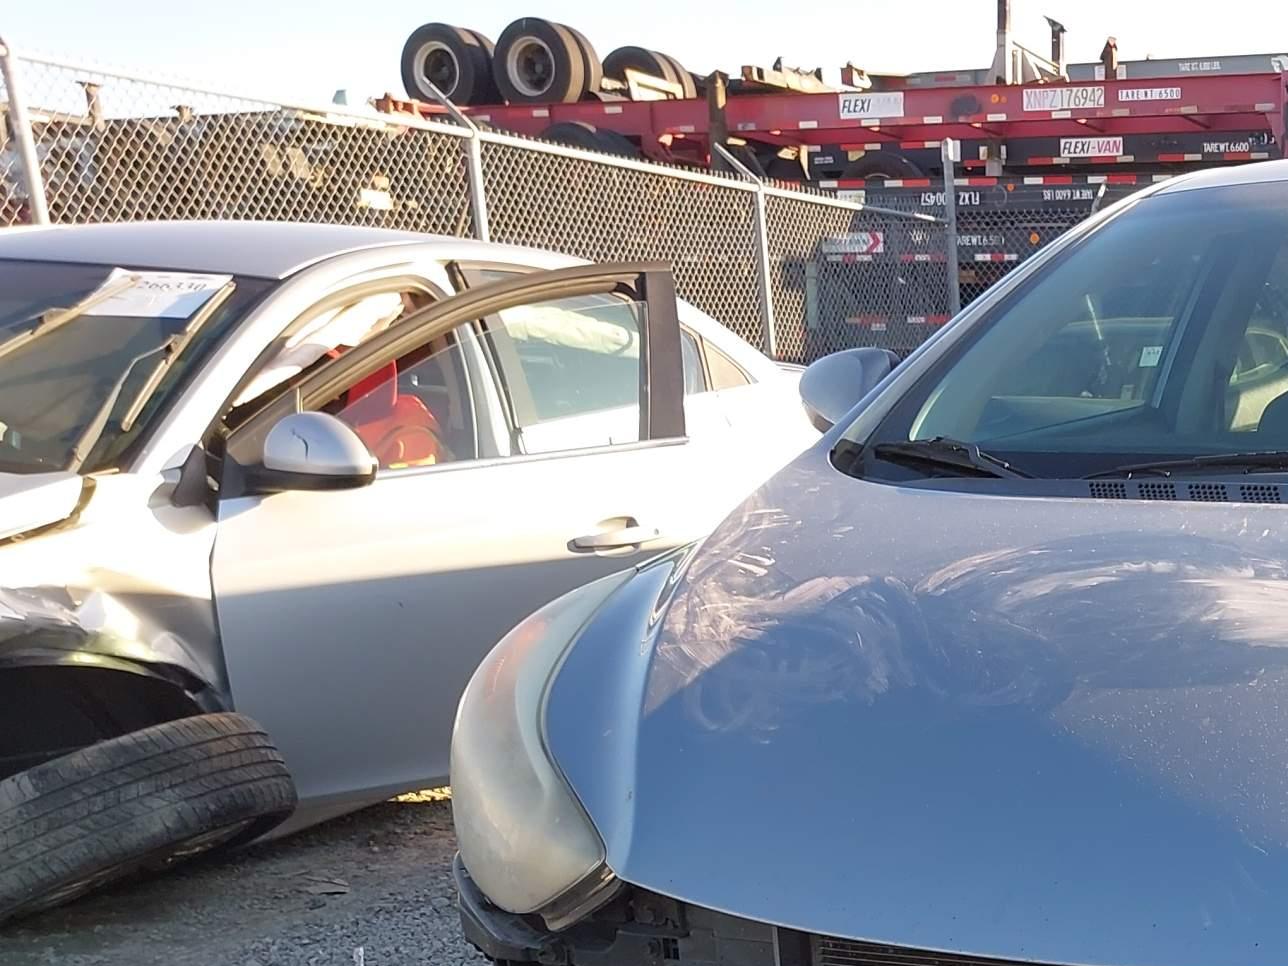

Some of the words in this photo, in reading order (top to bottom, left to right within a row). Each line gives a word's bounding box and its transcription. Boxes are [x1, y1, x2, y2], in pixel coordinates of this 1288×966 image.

[1158, 89, 1180, 98] 6500
[842, 98, 871, 113] FLEXI
[1062, 140, 1121, 154] FLEXI-VAN
